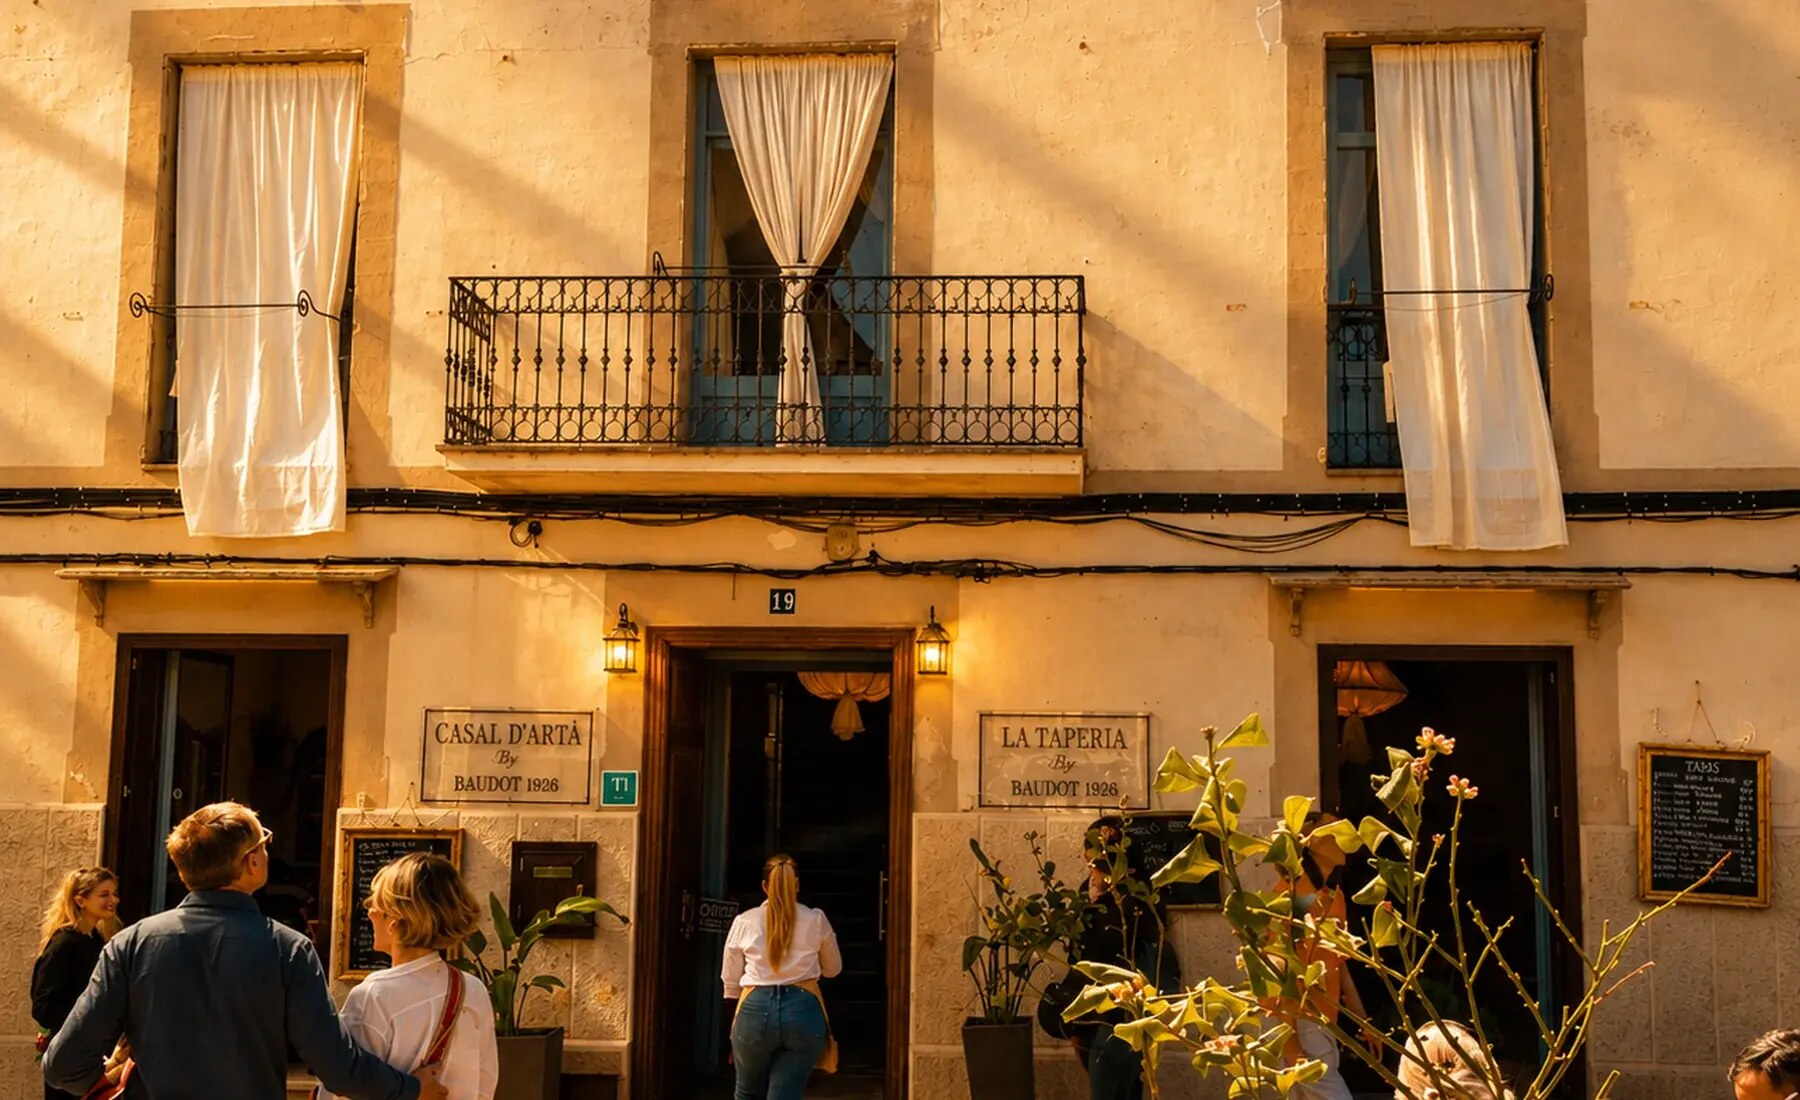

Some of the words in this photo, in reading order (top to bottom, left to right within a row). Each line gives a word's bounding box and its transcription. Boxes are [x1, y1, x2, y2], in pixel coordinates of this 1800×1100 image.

[773, 592, 794, 610] 19
[435, 722, 502, 745] CASAL
[1001, 727, 1030, 749] LA
[1035, 727, 1128, 750] TAPERIA
[493, 750, 519, 769] By
[1049, 754, 1076, 774] By
[454, 775, 522, 793] BAUDOT
[527, 777, 559, 793] 1926
[1011, 780, 1080, 797] BAUDOT
[1086, 781, 1118, 797] 1926
